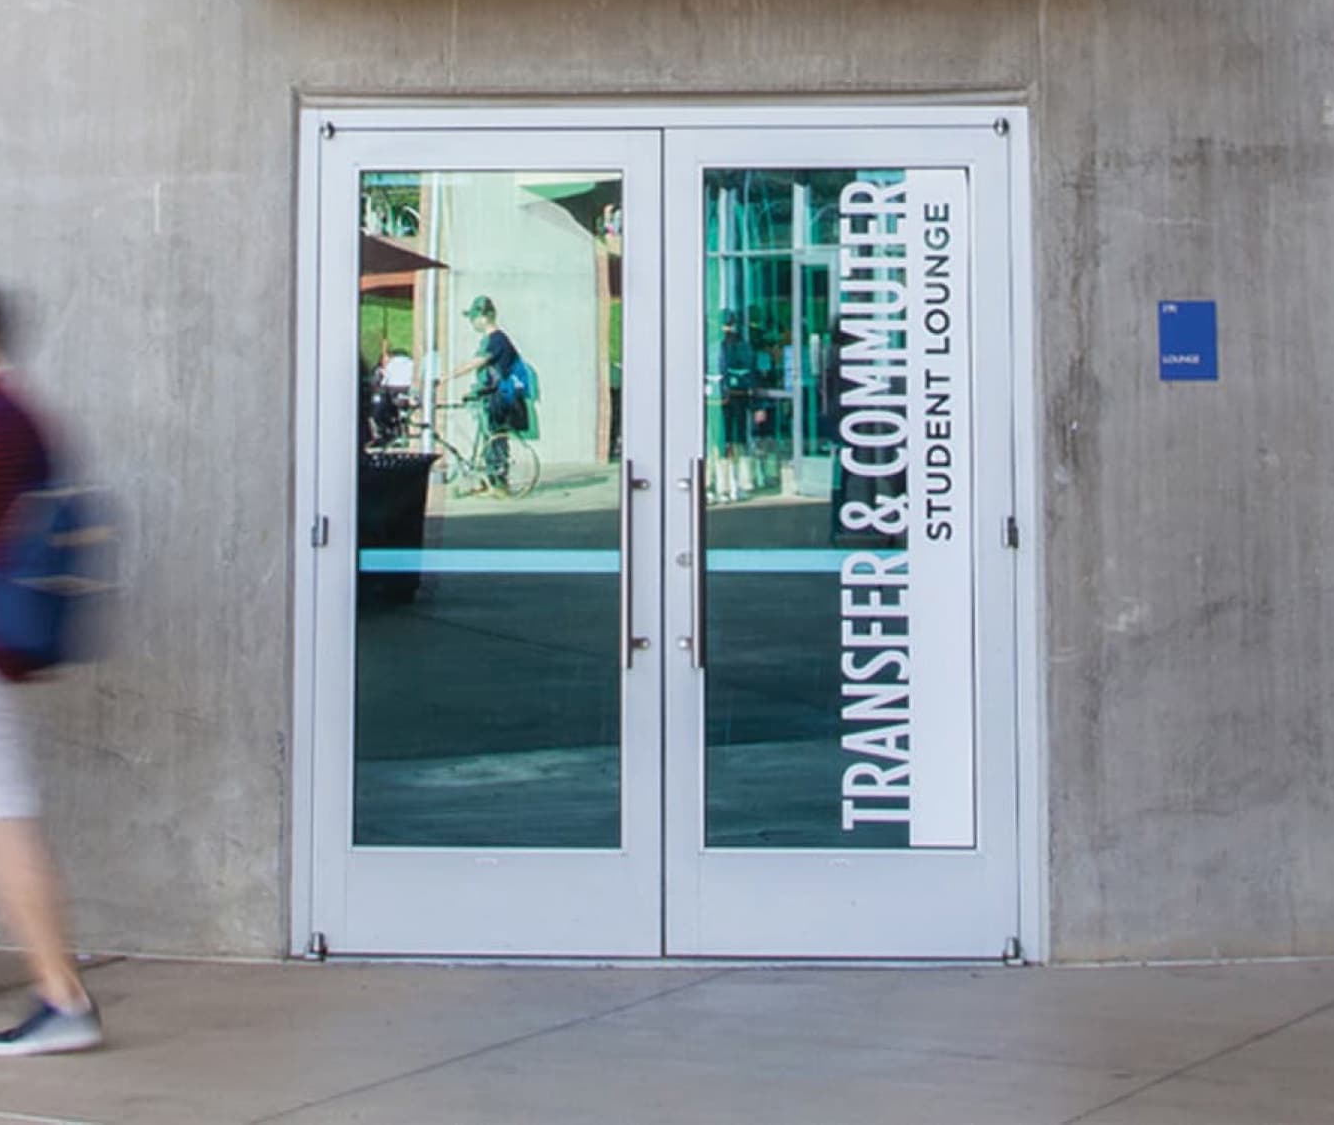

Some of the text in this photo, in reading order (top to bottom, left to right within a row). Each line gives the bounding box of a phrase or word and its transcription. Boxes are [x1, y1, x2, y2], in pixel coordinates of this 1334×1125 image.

[839, 180, 910, 831] TRANSFER & COMMUTER
[923, 202, 953, 541] STUDENT LOUNGE
